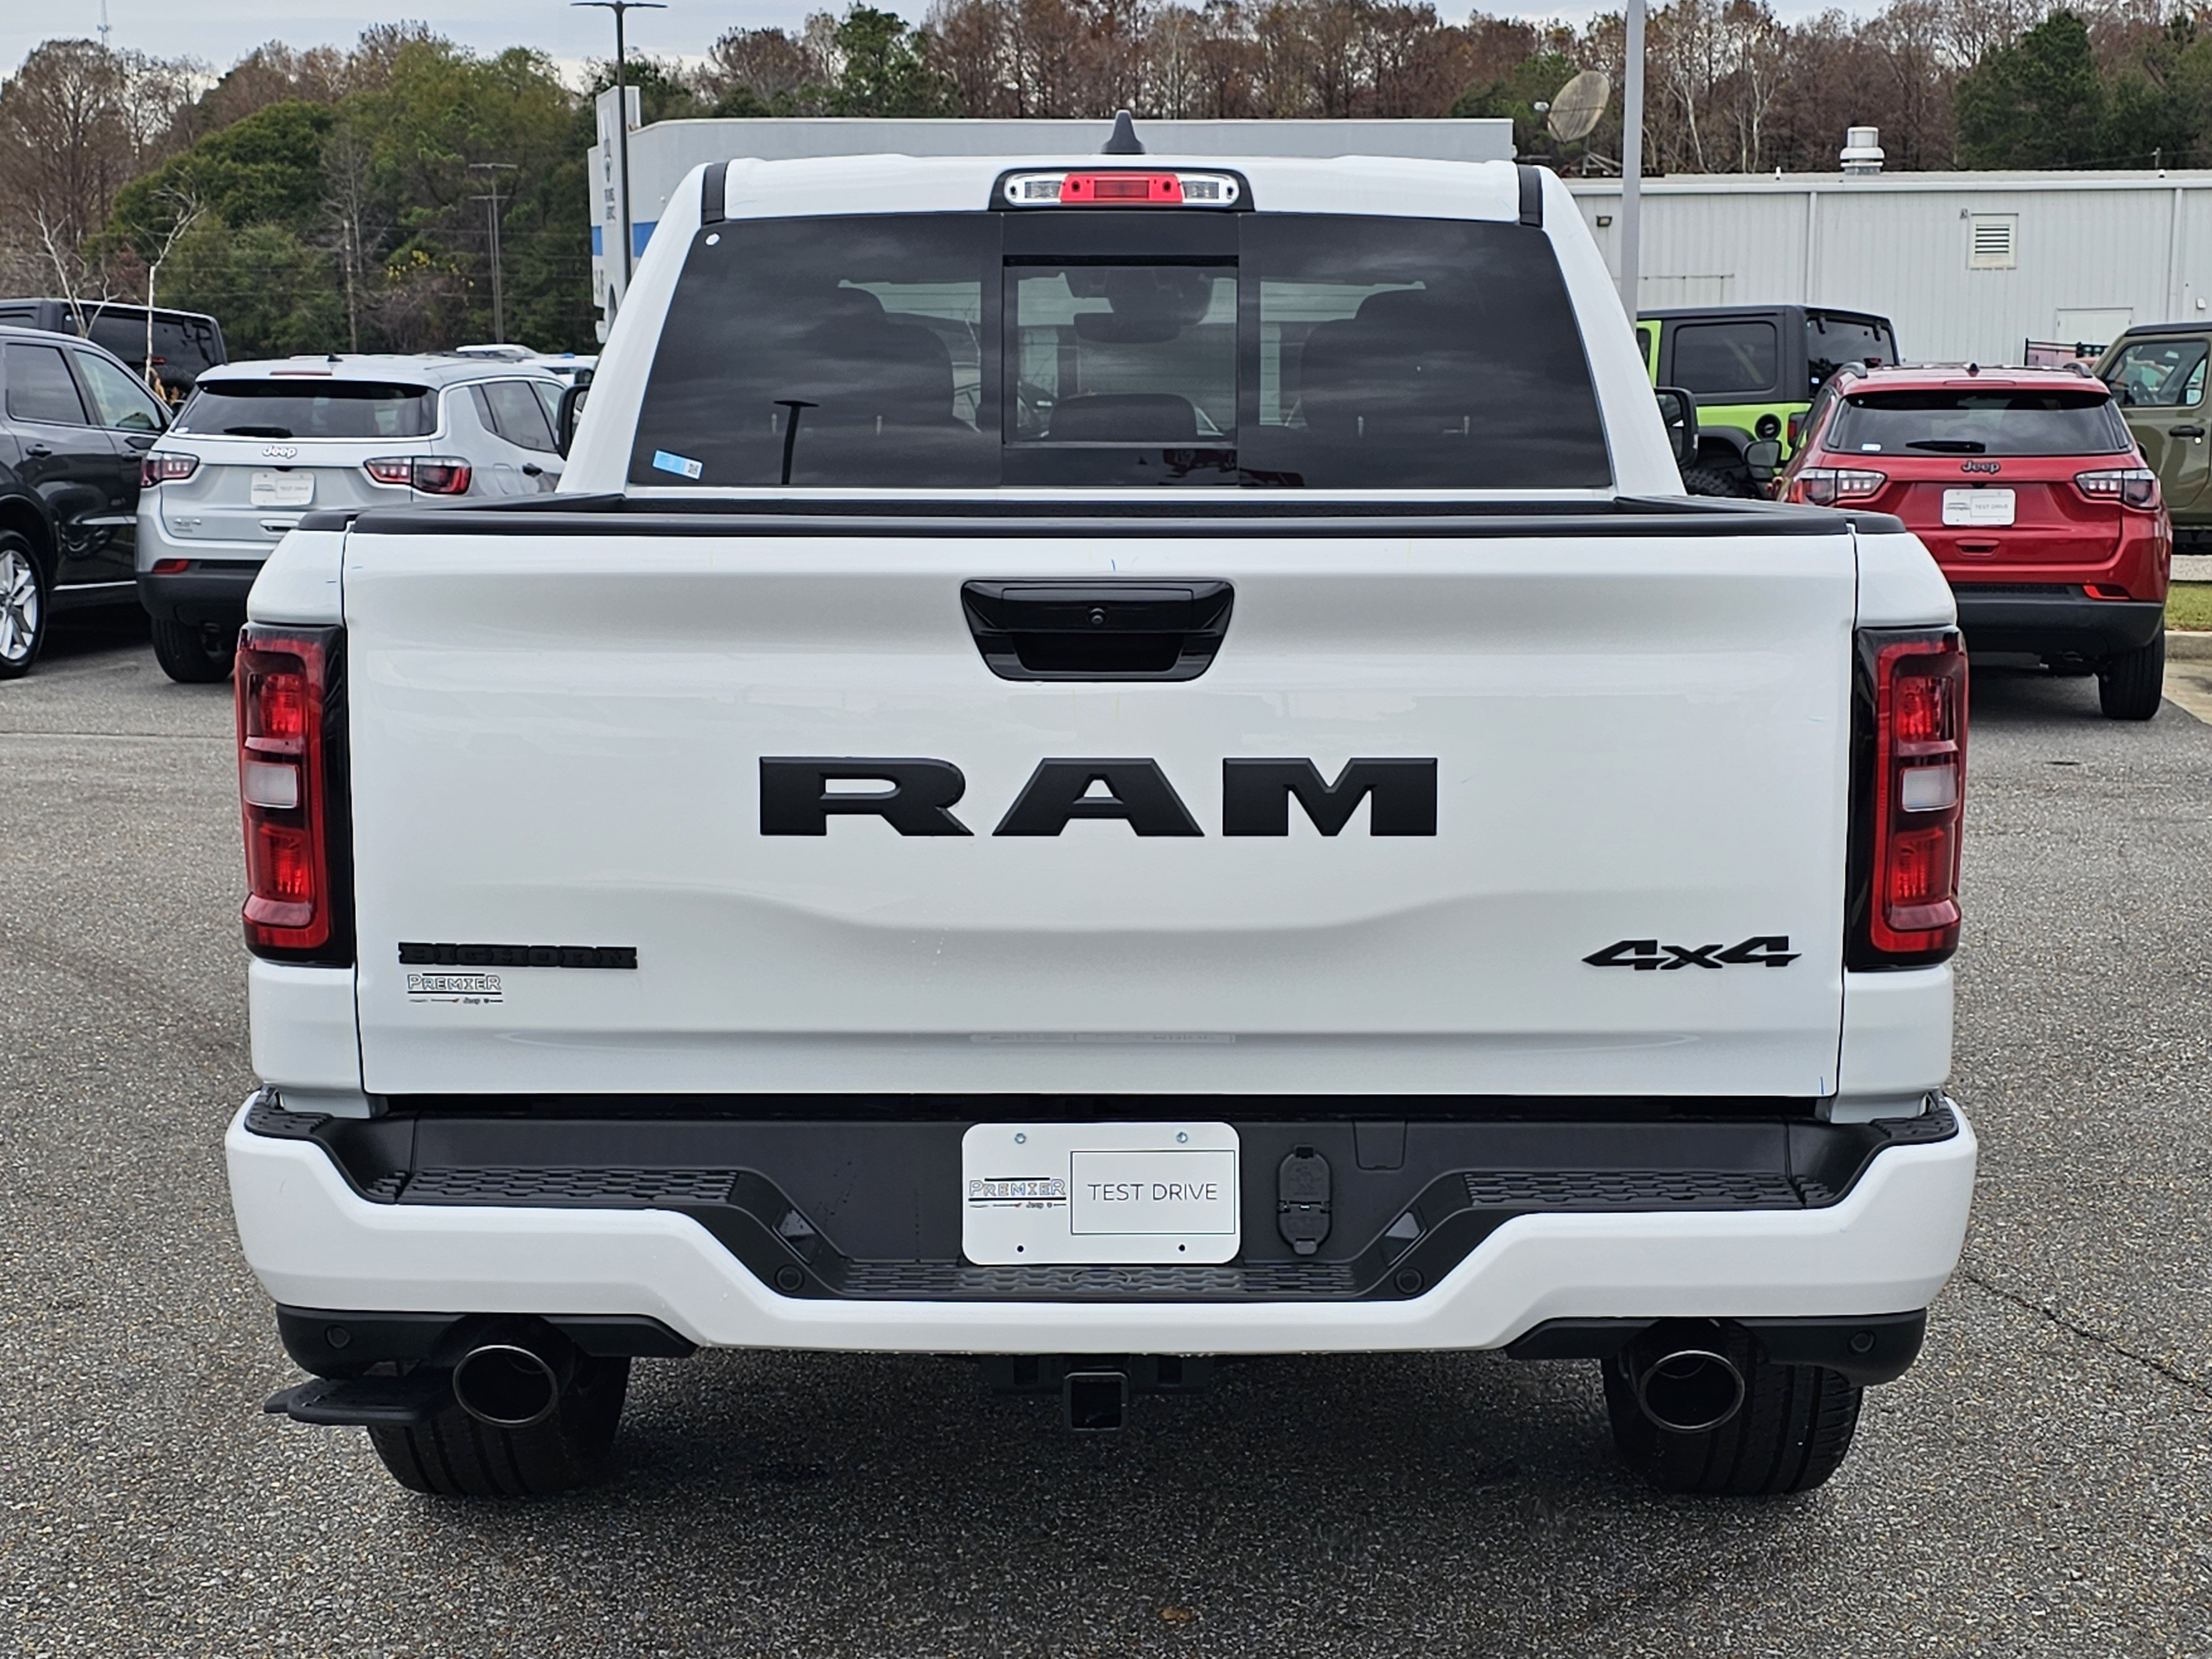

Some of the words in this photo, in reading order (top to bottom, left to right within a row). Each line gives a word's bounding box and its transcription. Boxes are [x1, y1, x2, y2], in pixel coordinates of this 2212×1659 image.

[262, 445, 298, 459] Jeep
[1961, 460, 2001, 474] Jeep
[760, 757, 1438, 836] RAM
[407, 974, 502, 990] PREMIER
[969, 1179, 1066, 1197] PREMIER
[1087, 1183, 1144, 1201] TEST
[1152, 1183, 1217, 1201] DRIVE
